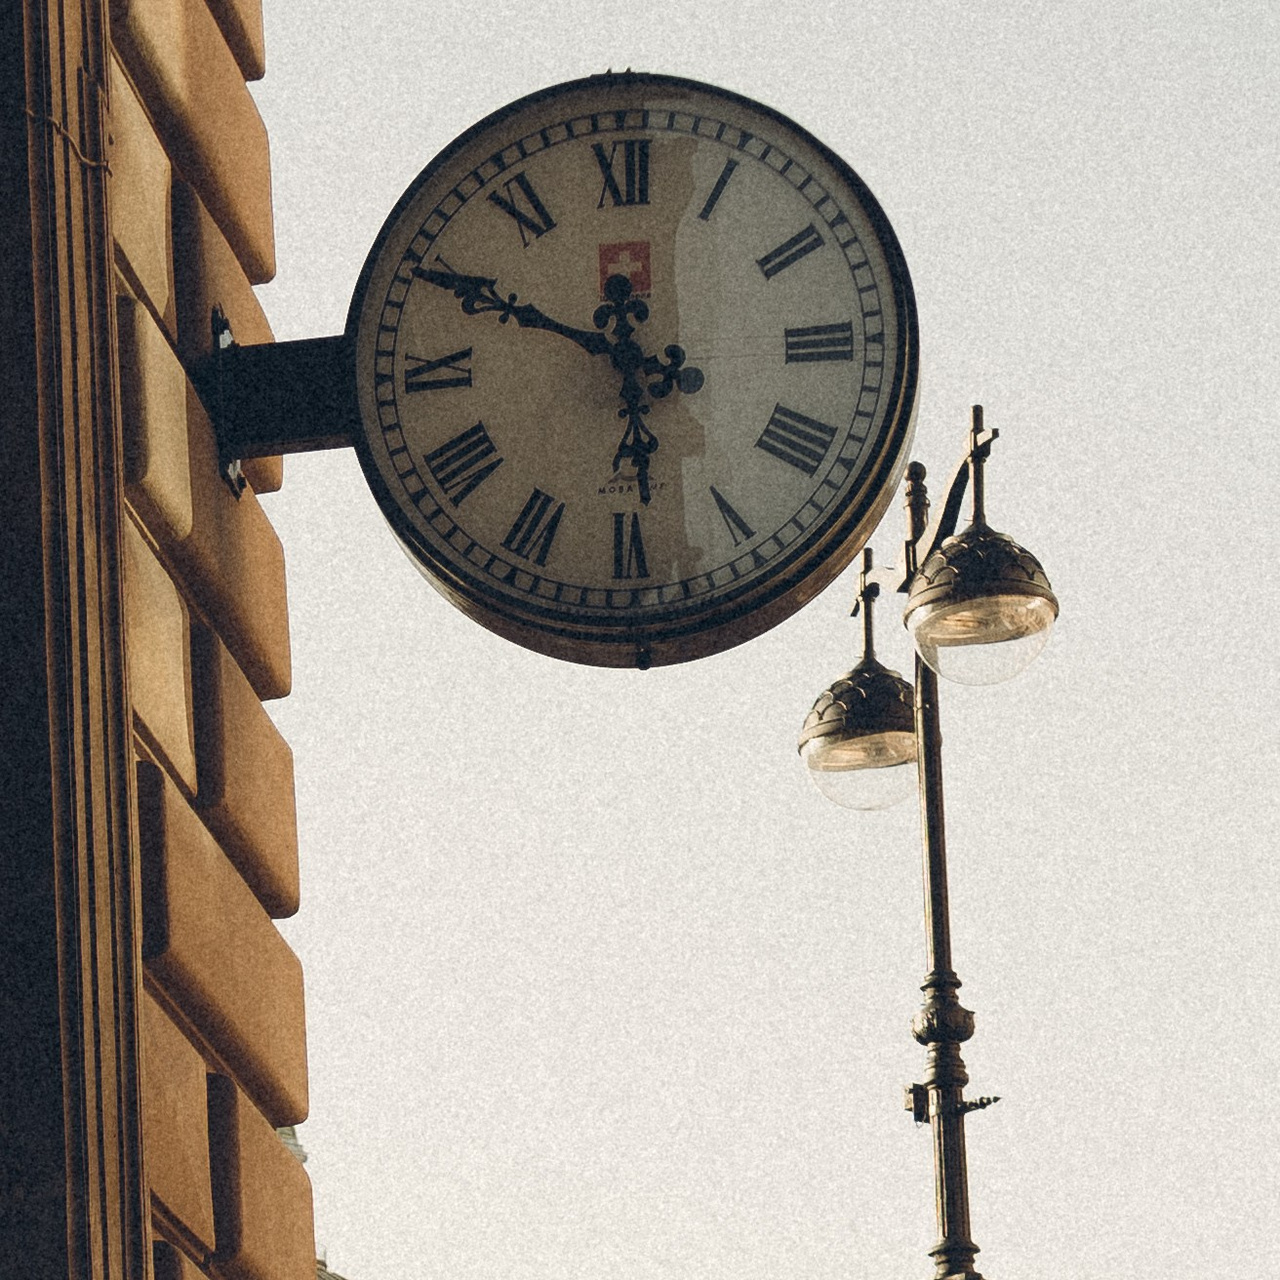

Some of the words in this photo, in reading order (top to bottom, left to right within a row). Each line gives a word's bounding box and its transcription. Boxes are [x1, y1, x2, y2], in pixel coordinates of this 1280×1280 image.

[591, 139, 652, 209] XII
[697, 157, 739, 222] I
[486, 171, 557, 249] XI
[754, 223, 825, 280] II
[405, 347, 472, 394] IX
[784, 320, 853, 364] III
[423, 420, 504, 508] VIII
[754, 402, 838, 479] IIII
[500, 487, 566, 567] VII
[612, 512, 650, 579] VI
[709, 474, 758, 547] V
